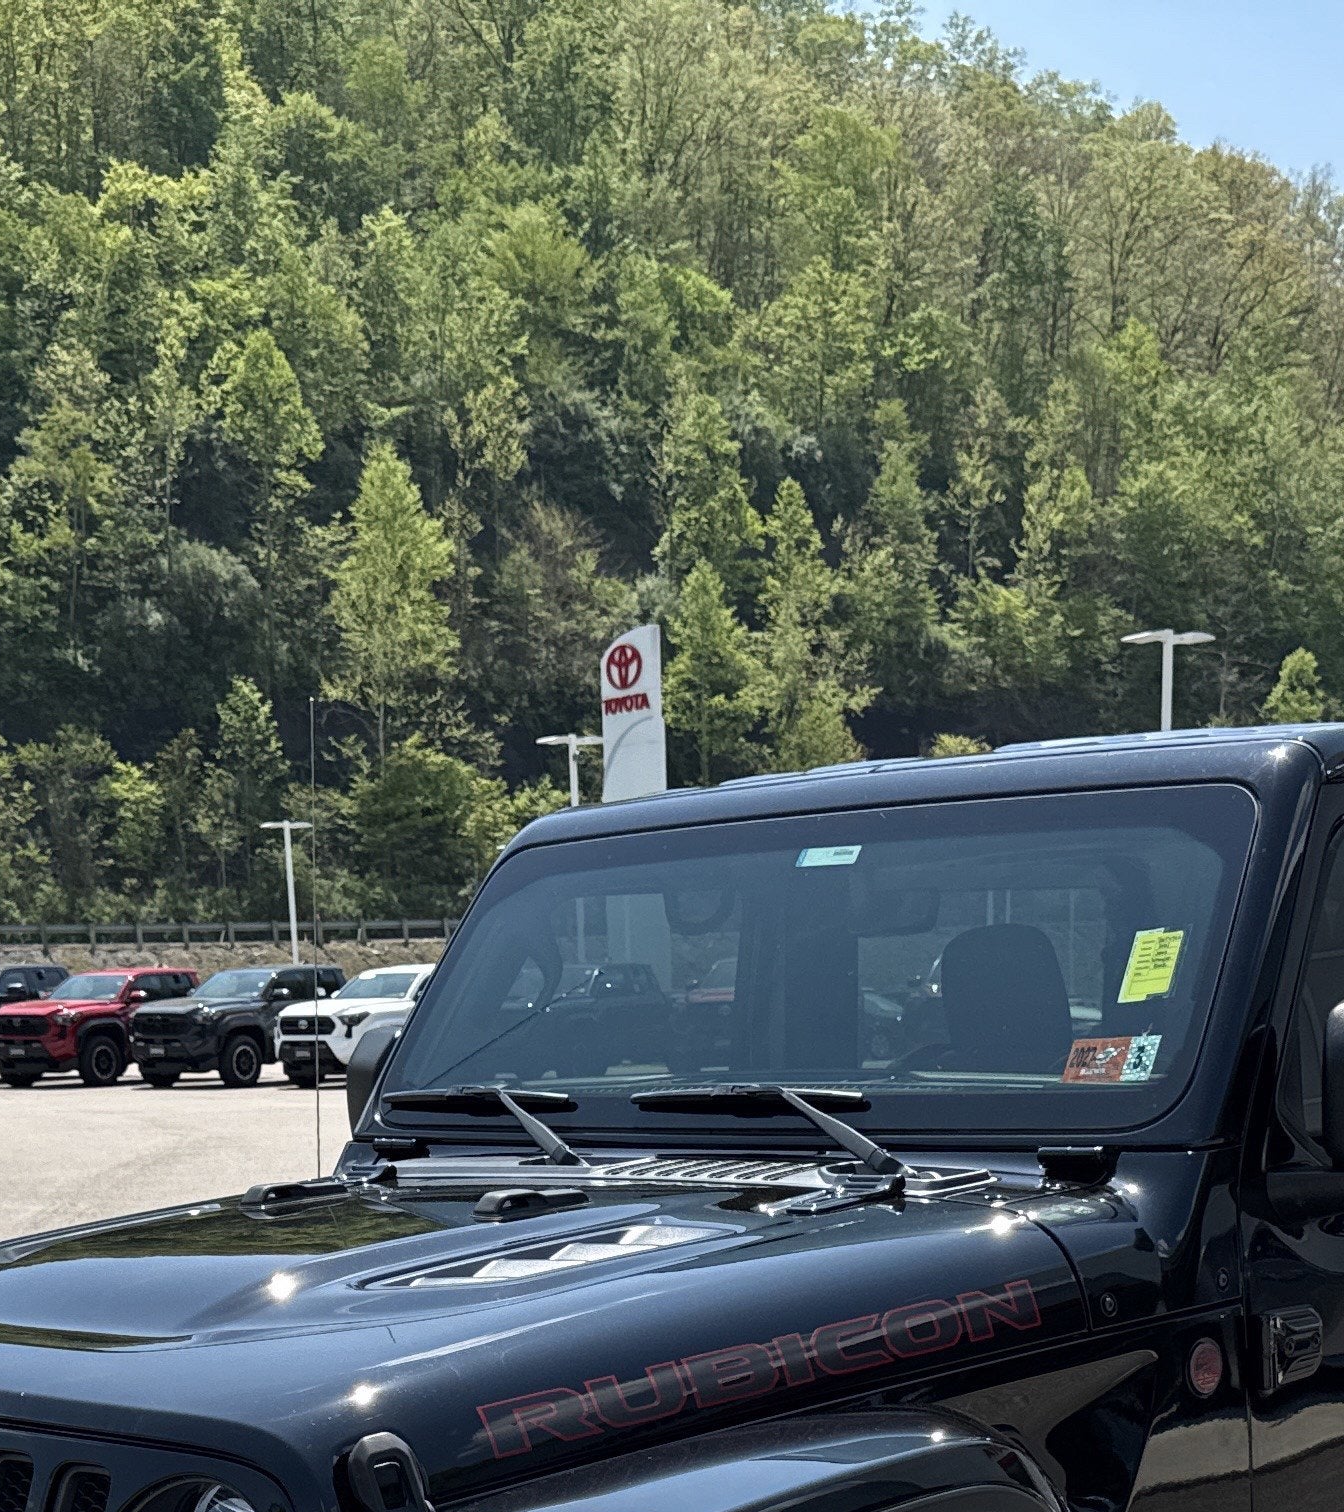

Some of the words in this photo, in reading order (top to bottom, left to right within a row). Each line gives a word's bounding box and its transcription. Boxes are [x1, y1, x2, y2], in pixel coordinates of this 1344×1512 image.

[603, 692, 650, 716] TOYOTA
[1133, 1045, 1146, 1070] 3
[475, 1279, 1044, 1459] RUBICON
